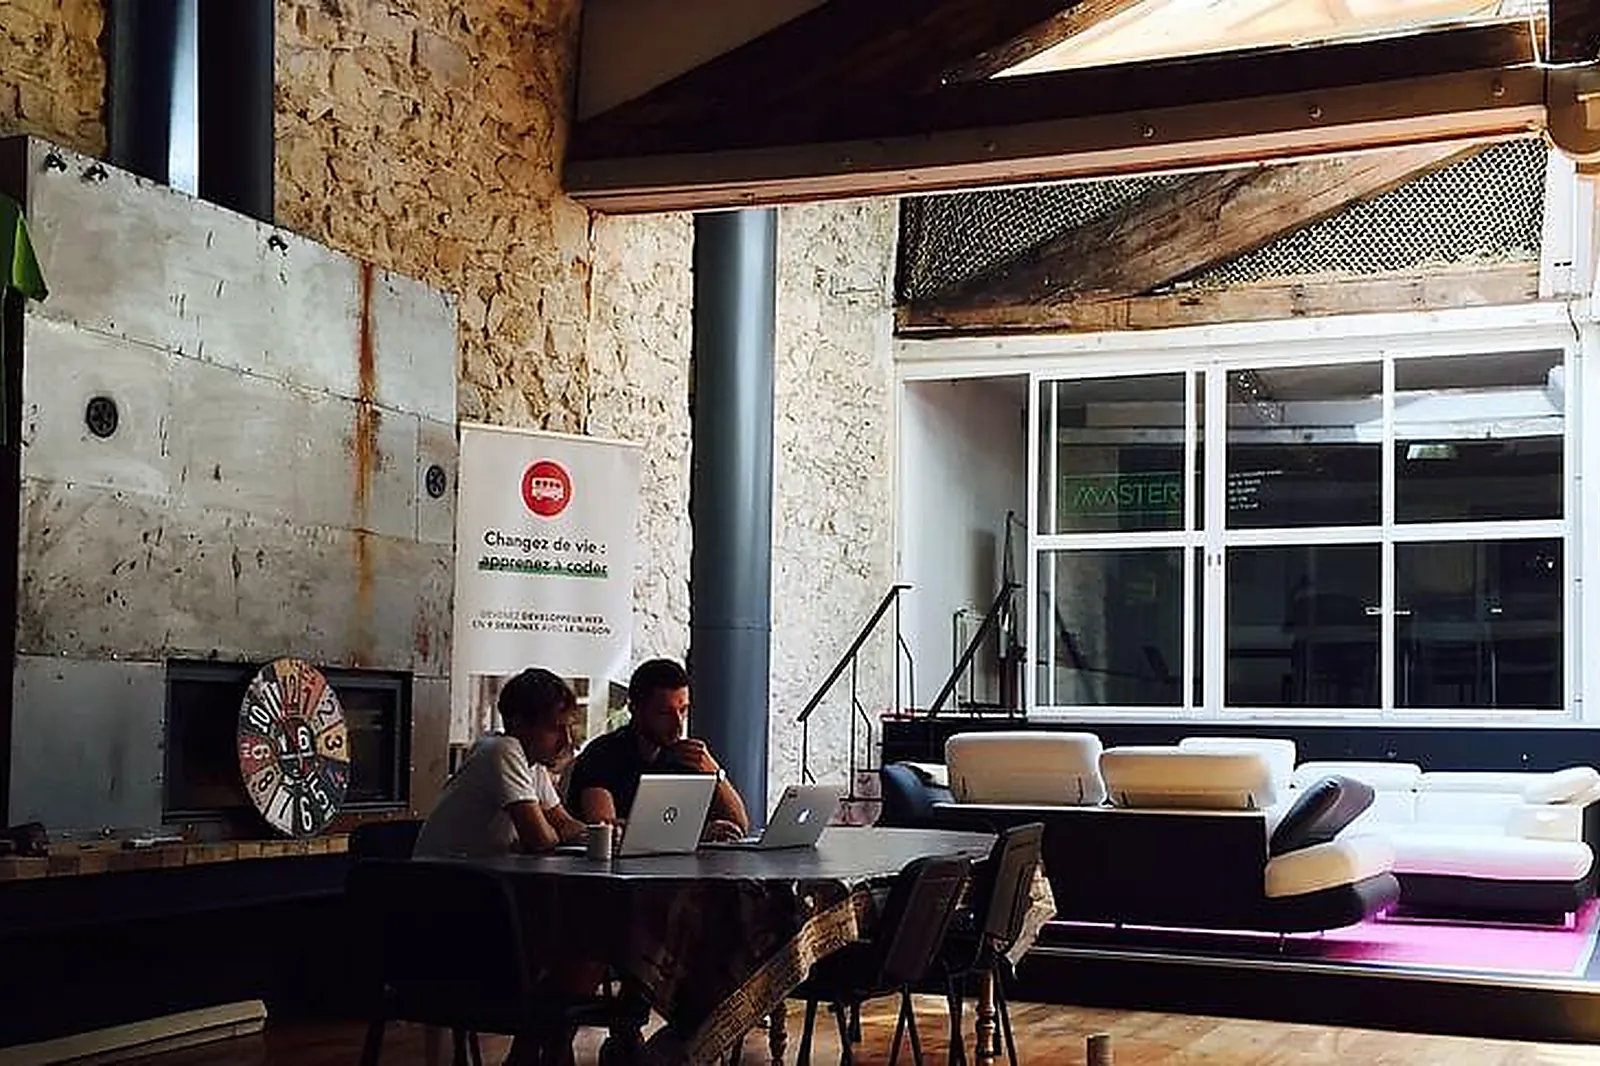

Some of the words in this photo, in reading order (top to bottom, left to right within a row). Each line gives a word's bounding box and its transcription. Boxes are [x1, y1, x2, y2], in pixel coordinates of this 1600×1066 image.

[484, 531, 549, 553] Changez
[553, 536, 571, 551] de
[575, 539, 597, 554] vie
[479, 556, 550, 571] apprenez
[552, 558, 563, 571] à
[567, 560, 608, 574] coder
[472, 620, 486, 629] EN
[494, 621, 540, 631] SEMAINES
[564, 625, 575, 634] LE
[576, 626, 611, 636] WAGON
[584, 615, 604, 624] WEB
[249, 705, 271, 734] 10
[324, 734, 342, 752] 3
[258, 771, 275, 792] 8
[280, 786, 296, 819] 7
[310, 777, 329, 811] 5
[300, 796, 313, 831] 6
